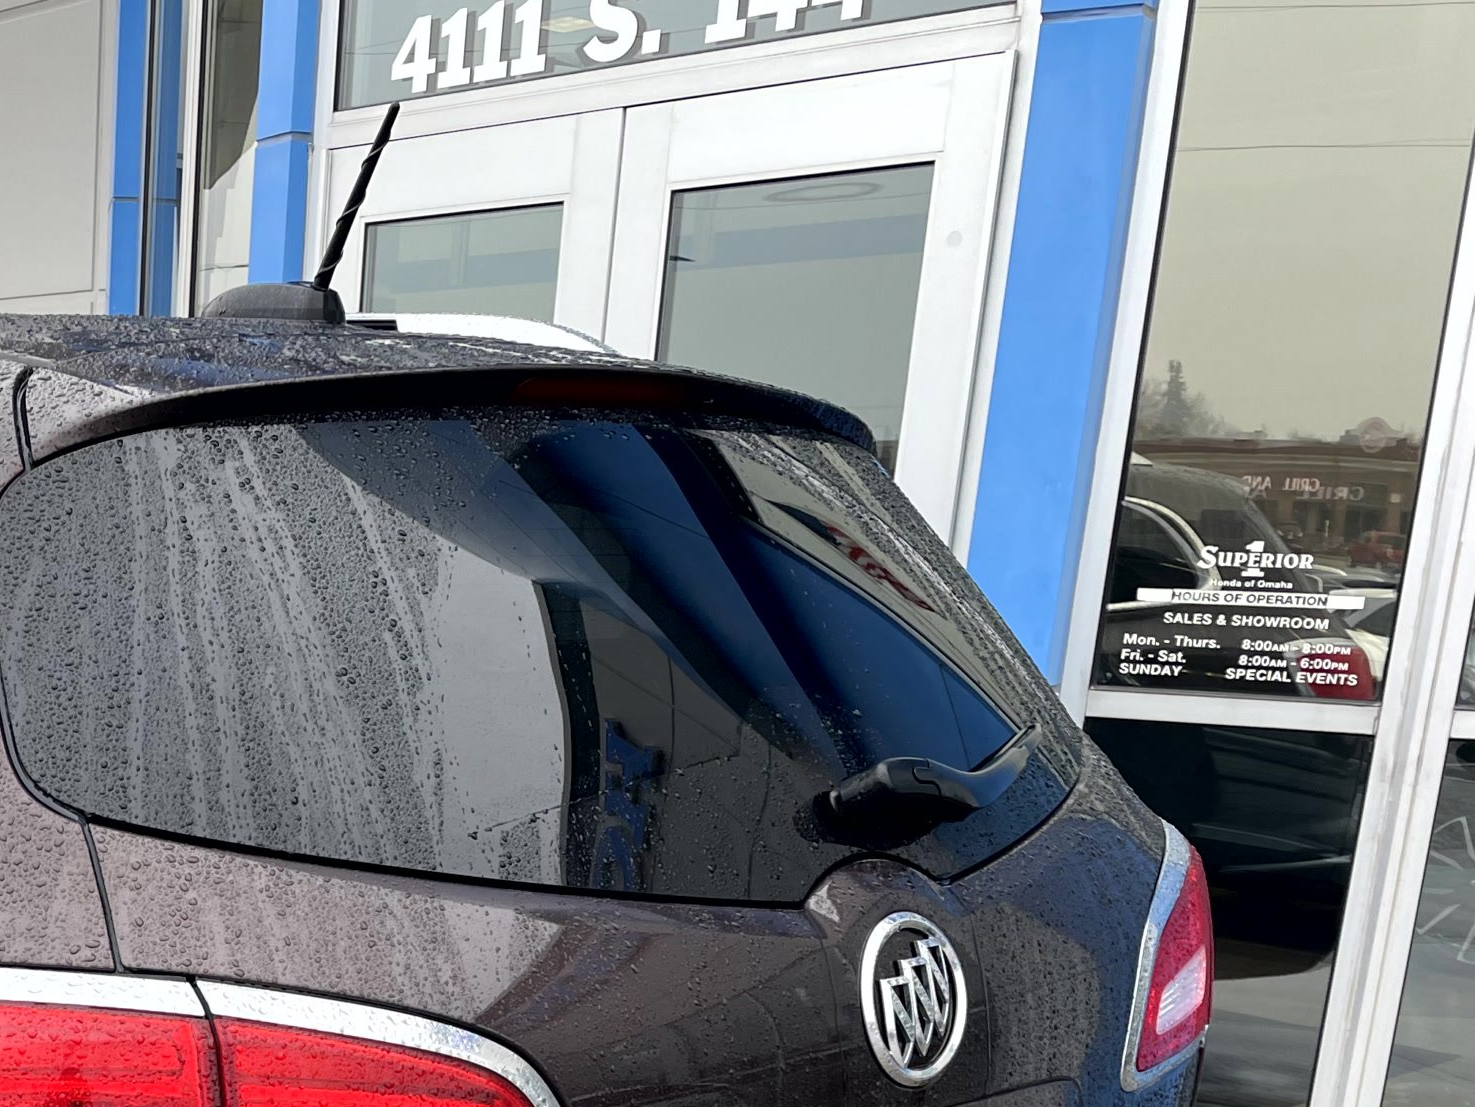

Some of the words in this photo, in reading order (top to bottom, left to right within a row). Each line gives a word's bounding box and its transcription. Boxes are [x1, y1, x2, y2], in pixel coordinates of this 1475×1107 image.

[390, 0, 547, 94] 4111
[583, 0, 662, 63] S.
[1196, 545, 1314, 570] SUPERIOR
[1210, 579, 1242, 588] Honda
[1244, 580, 1255, 588] of
[1257, 581, 1293, 589] Omaha
[1172, 590, 1220, 603] HOURS
[1223, 593, 1243, 604] OF
[1246, 594, 1328, 607] OPERATION
[1163, 612, 1213, 626] SALES
[1216, 614, 1227, 626] &
[1231, 614, 1330, 631] SHOWROOM
[1123, 633, 1160, 647] Mon.
[1174, 634, 1221, 650] Thurs.
[1120, 649, 1145, 662] Fri.
[1157, 650, 1187, 664] Sat.
[1119, 662, 1182, 678] SUNDAY
[1225, 667, 1292, 684] SPECIAL
[1295, 672, 1358, 687] EVENTS
